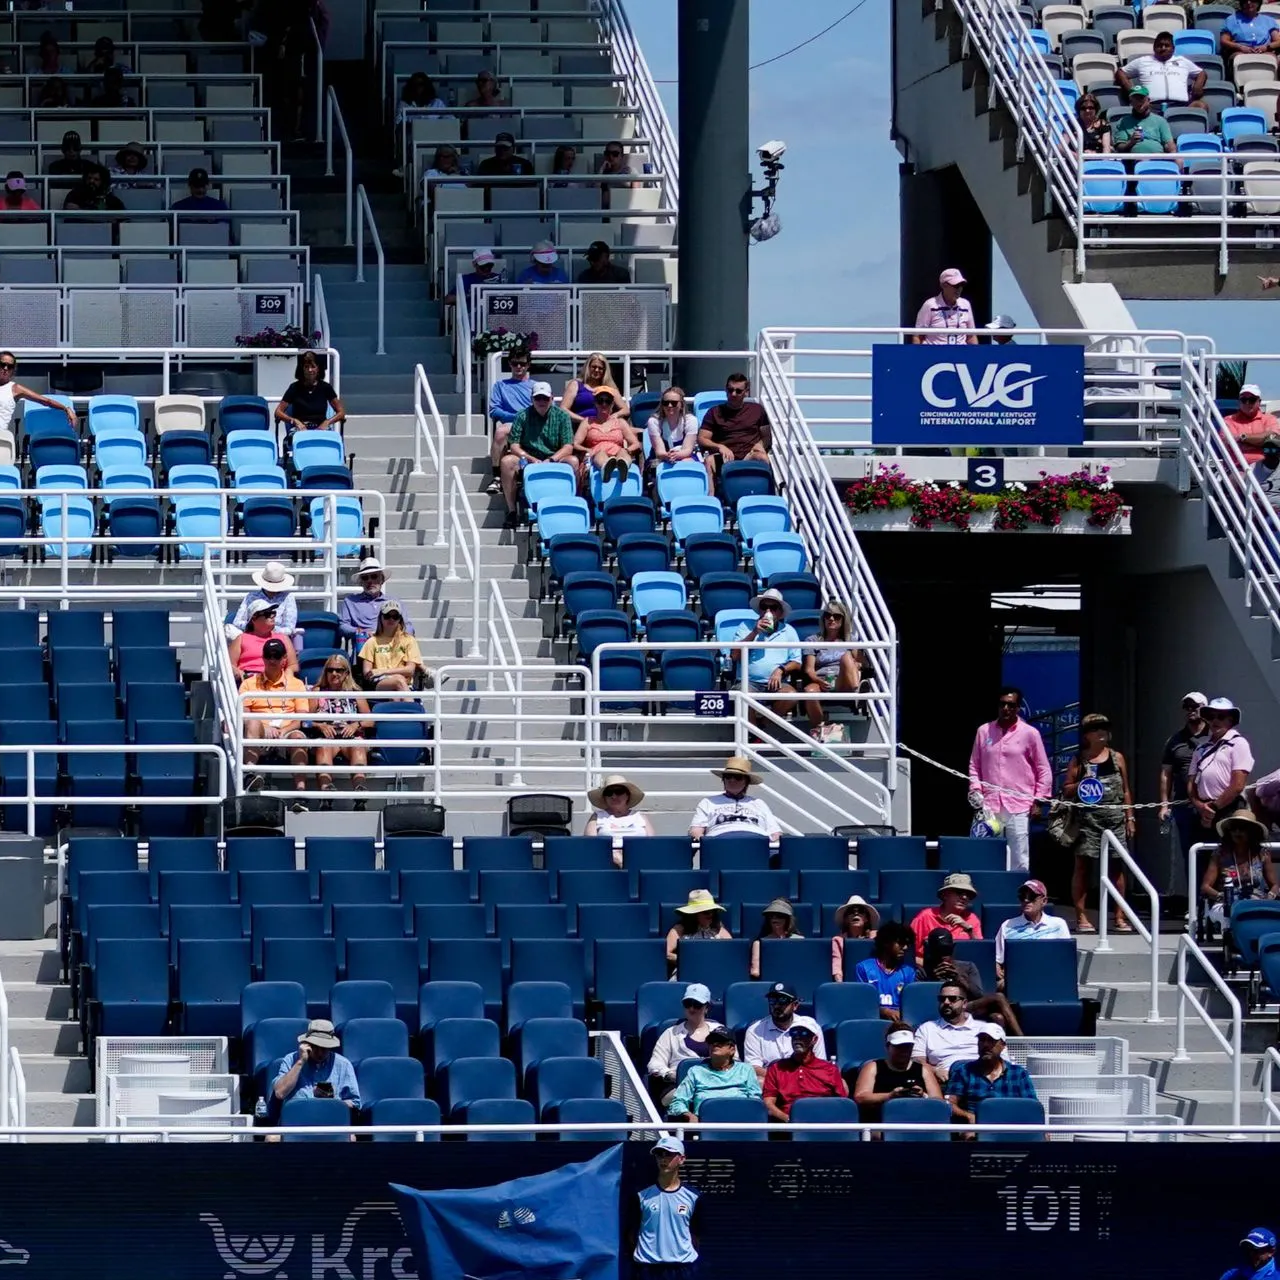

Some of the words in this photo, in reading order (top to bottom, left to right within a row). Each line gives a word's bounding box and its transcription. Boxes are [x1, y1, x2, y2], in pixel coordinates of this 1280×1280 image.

[260, 299, 281, 308] 309
[493, 300, 514, 309] 309
[921, 363, 1048, 408] CVG
[974, 465, 997, 488] 3
[700, 699, 724, 710] 208
[996, 1184, 1081, 1231] 101
